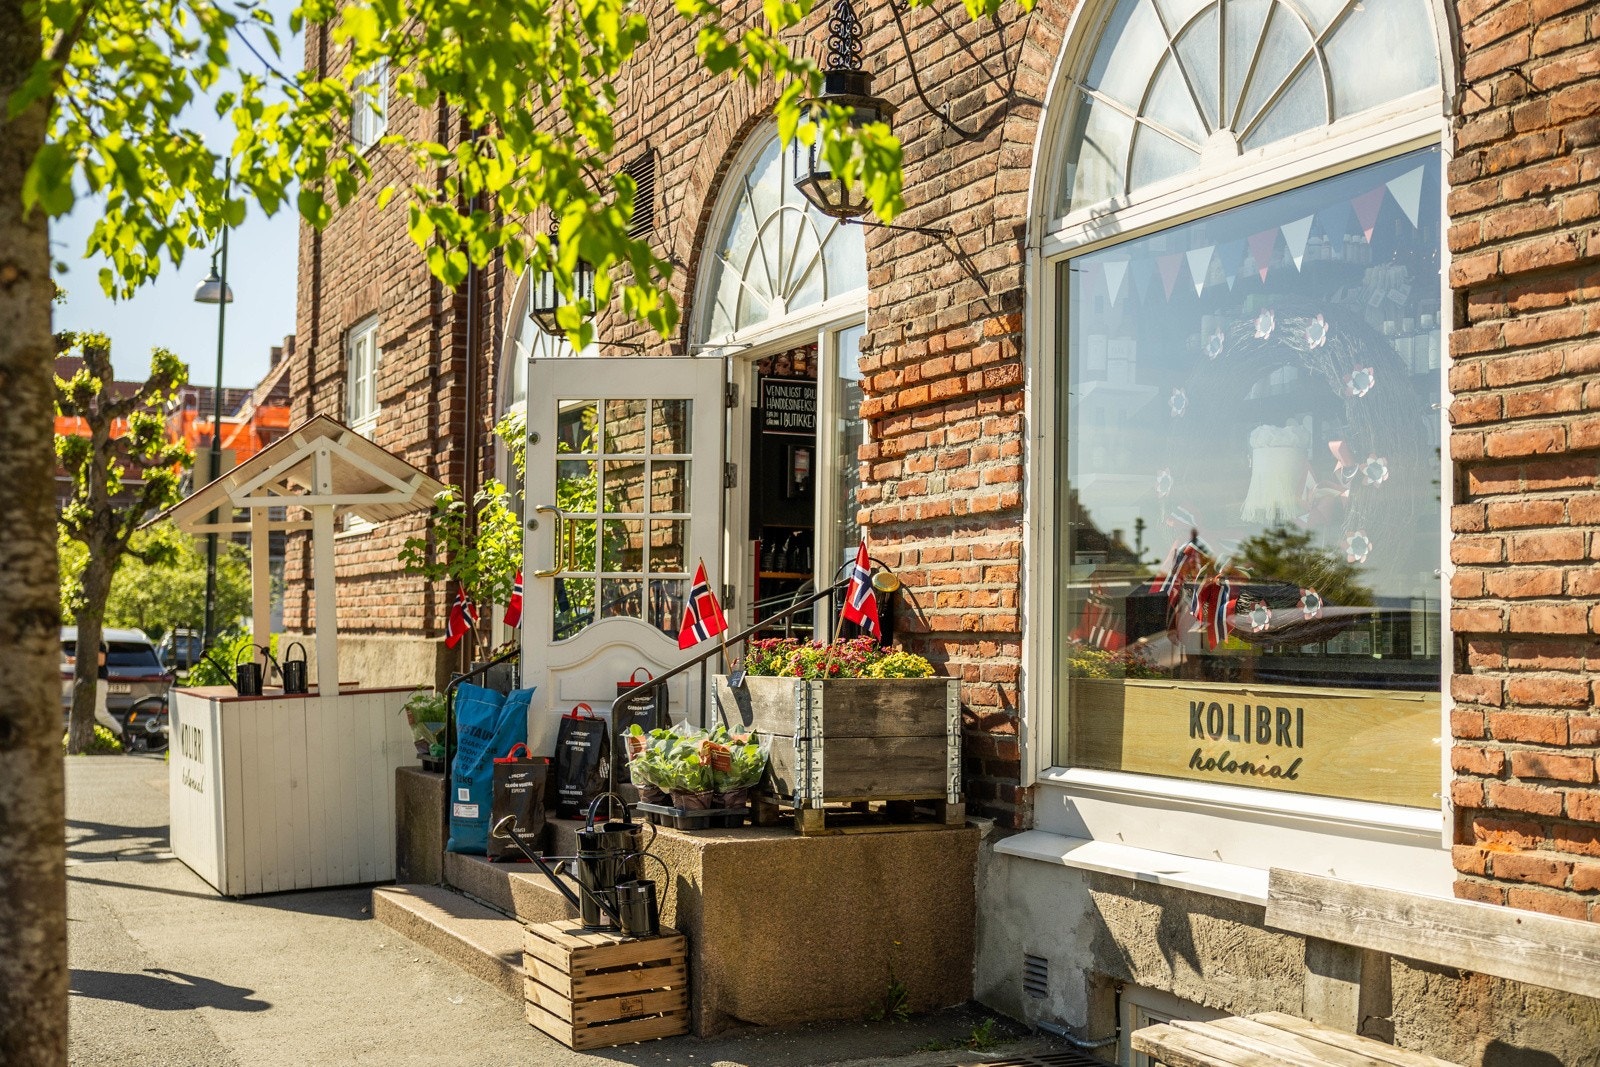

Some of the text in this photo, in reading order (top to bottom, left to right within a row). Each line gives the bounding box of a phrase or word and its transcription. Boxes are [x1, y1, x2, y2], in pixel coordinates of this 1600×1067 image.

[765, 385, 802, 398] VENNLIGST
[1189, 701, 1304, 749] KOLIBRI
[181, 723, 204, 764] KOLIBRI
[1189, 748, 1304, 780] kolonial
